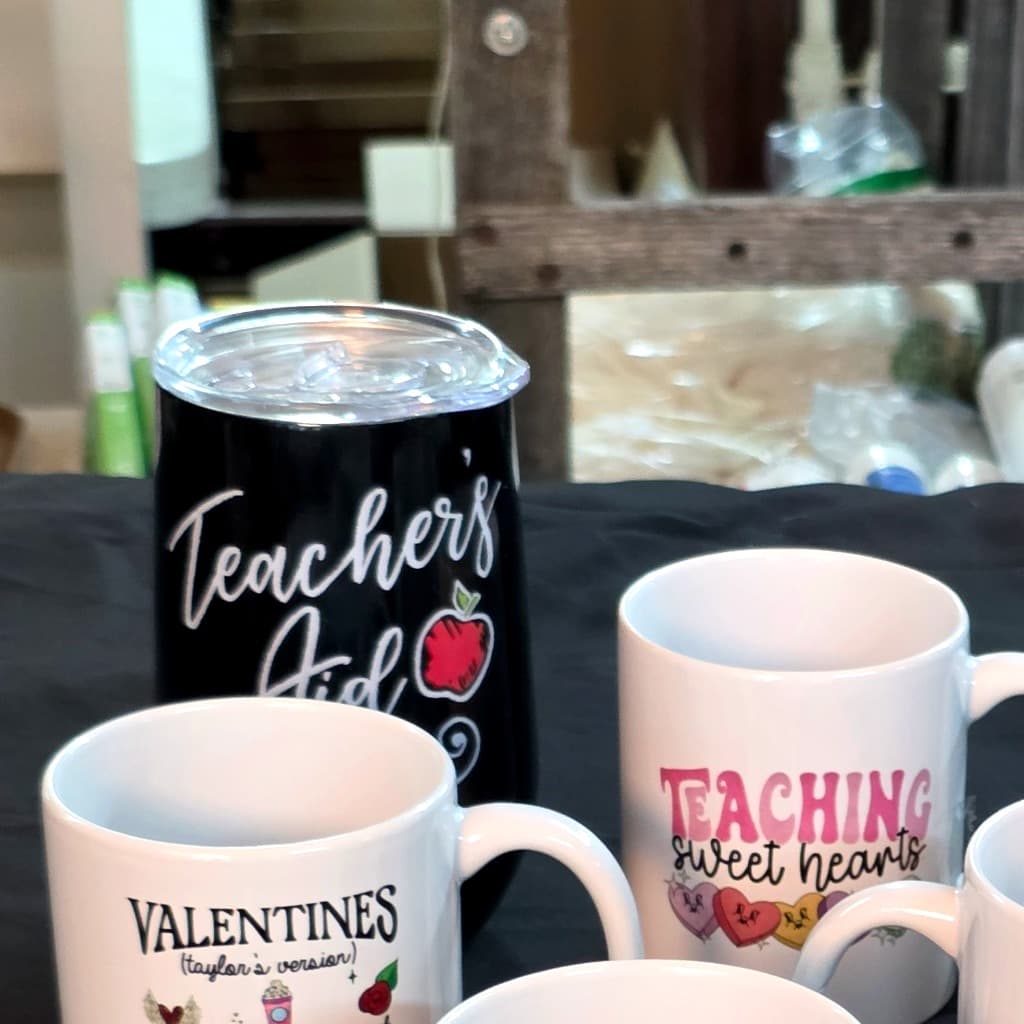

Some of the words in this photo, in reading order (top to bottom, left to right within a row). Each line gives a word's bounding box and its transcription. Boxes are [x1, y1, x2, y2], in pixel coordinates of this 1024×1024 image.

[167, 447, 501, 629] Teacher's
[660, 767, 932, 844] TEACHING
[672, 834, 785, 886] sweet
[800, 827, 926, 892] hearts
[127, 884, 398, 955] VALENTINES
[180, 952, 271, 982] (taylor's
[277, 941, 357, 974] version)
